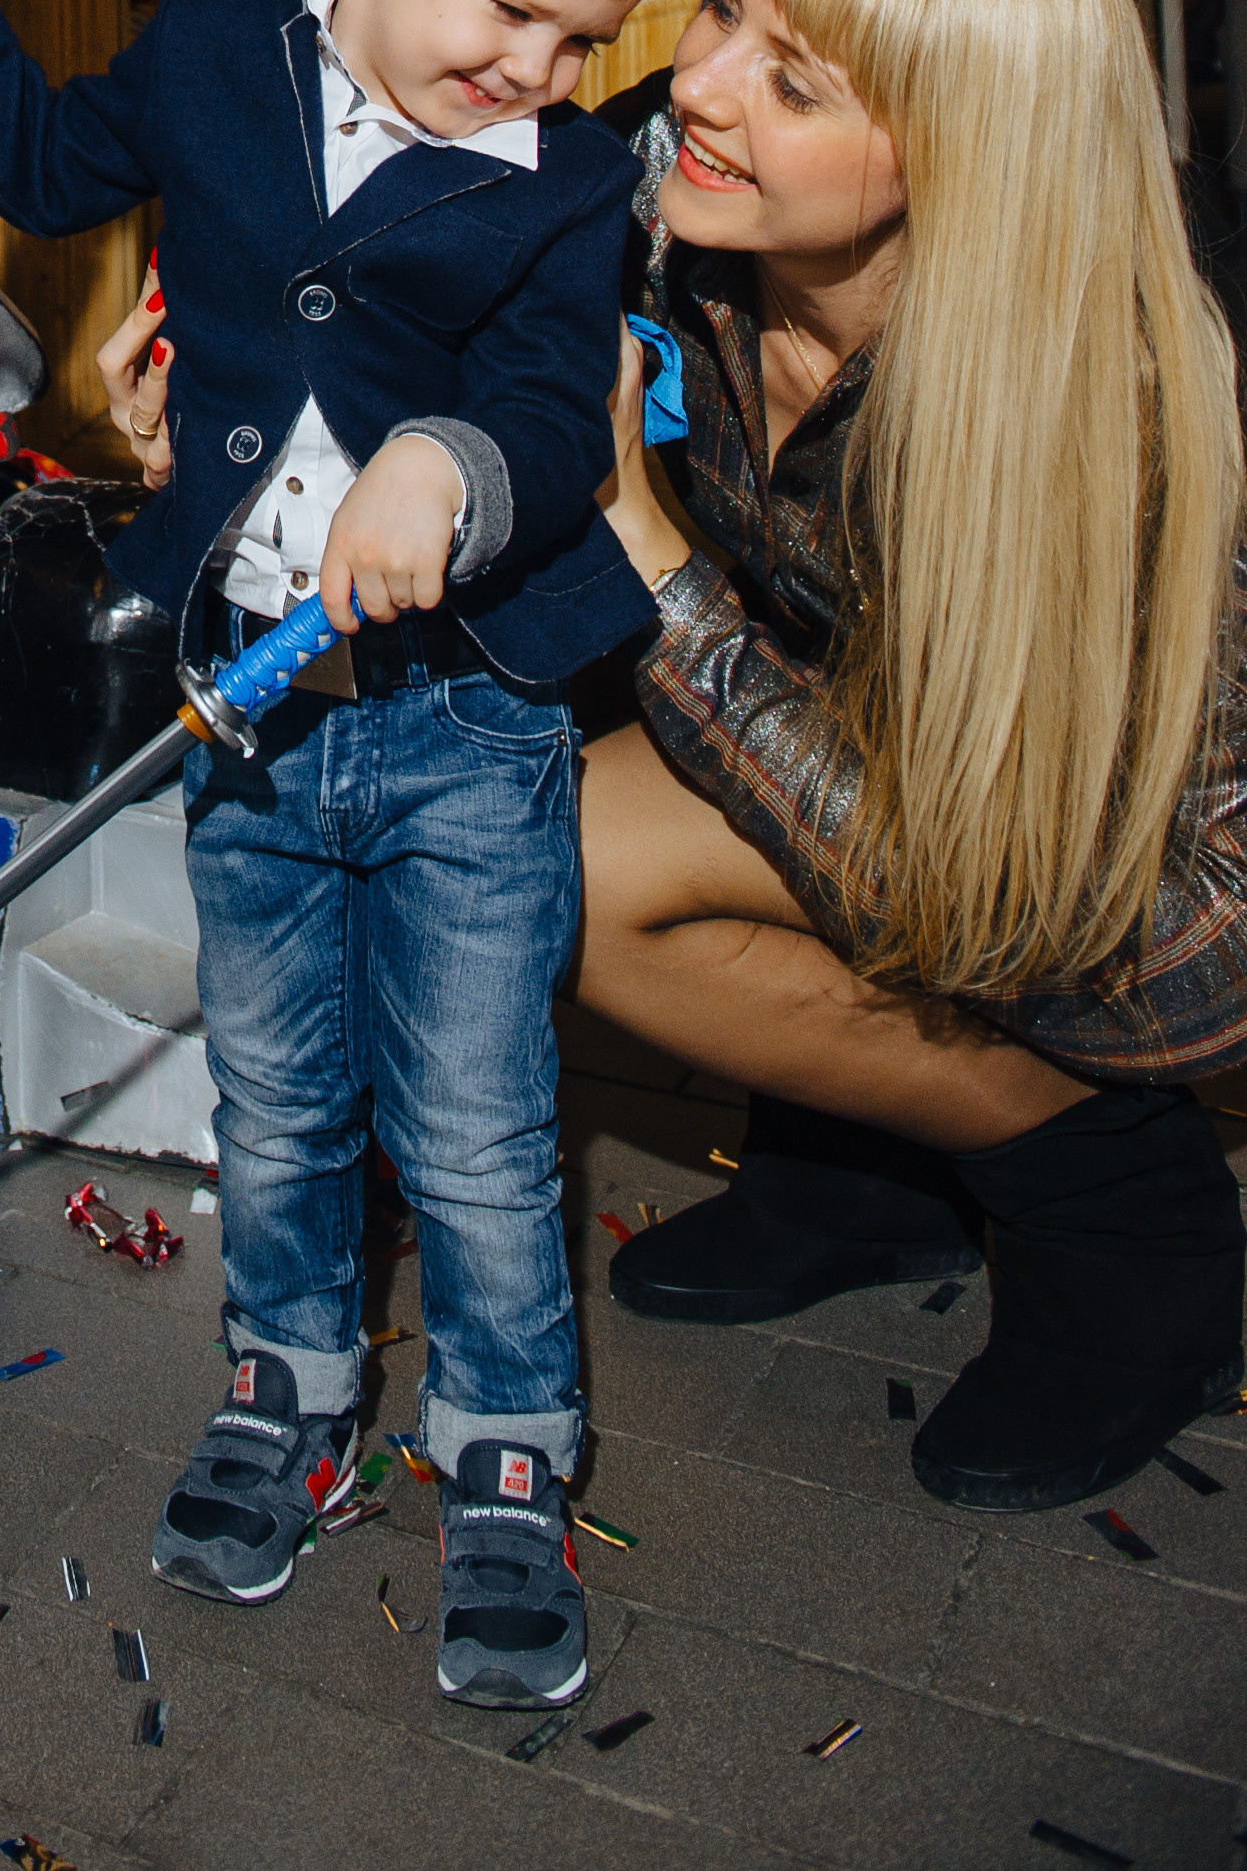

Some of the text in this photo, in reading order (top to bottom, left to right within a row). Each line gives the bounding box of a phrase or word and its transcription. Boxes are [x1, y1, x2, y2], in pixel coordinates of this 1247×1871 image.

[233, 1414, 282, 1436] balance
[463, 1506, 547, 1527] new balance
